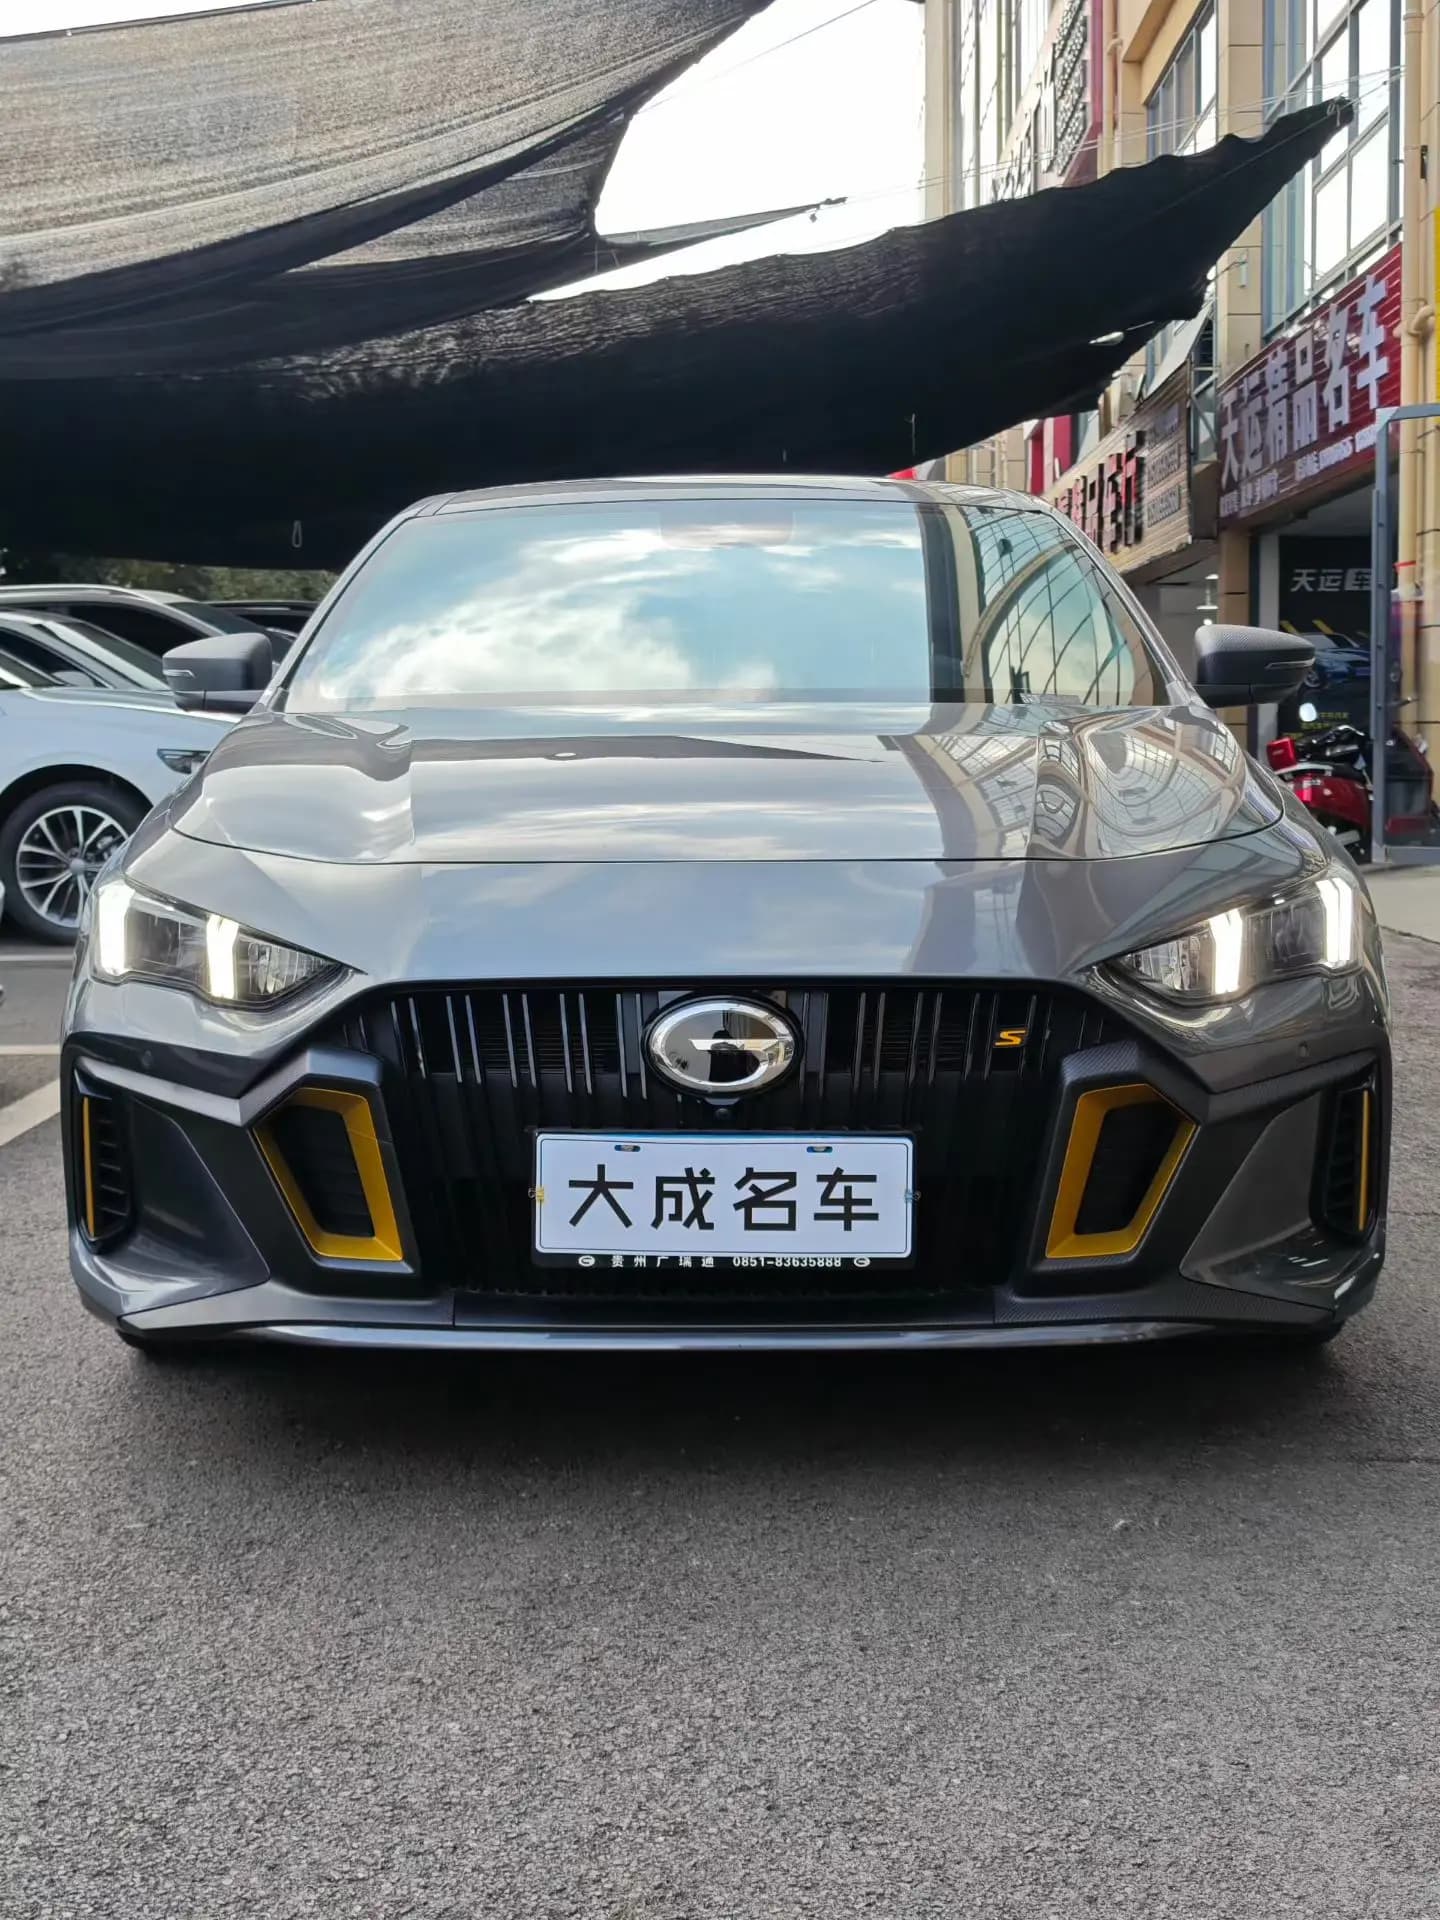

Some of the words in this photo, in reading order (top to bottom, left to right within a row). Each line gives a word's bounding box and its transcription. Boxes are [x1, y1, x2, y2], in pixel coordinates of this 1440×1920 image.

[1221, 273, 1390, 491] 天运精品名车
[568, 1163, 879, 1232] 大成名车
[733, 1255, 842, 1267] 0851-83635888
